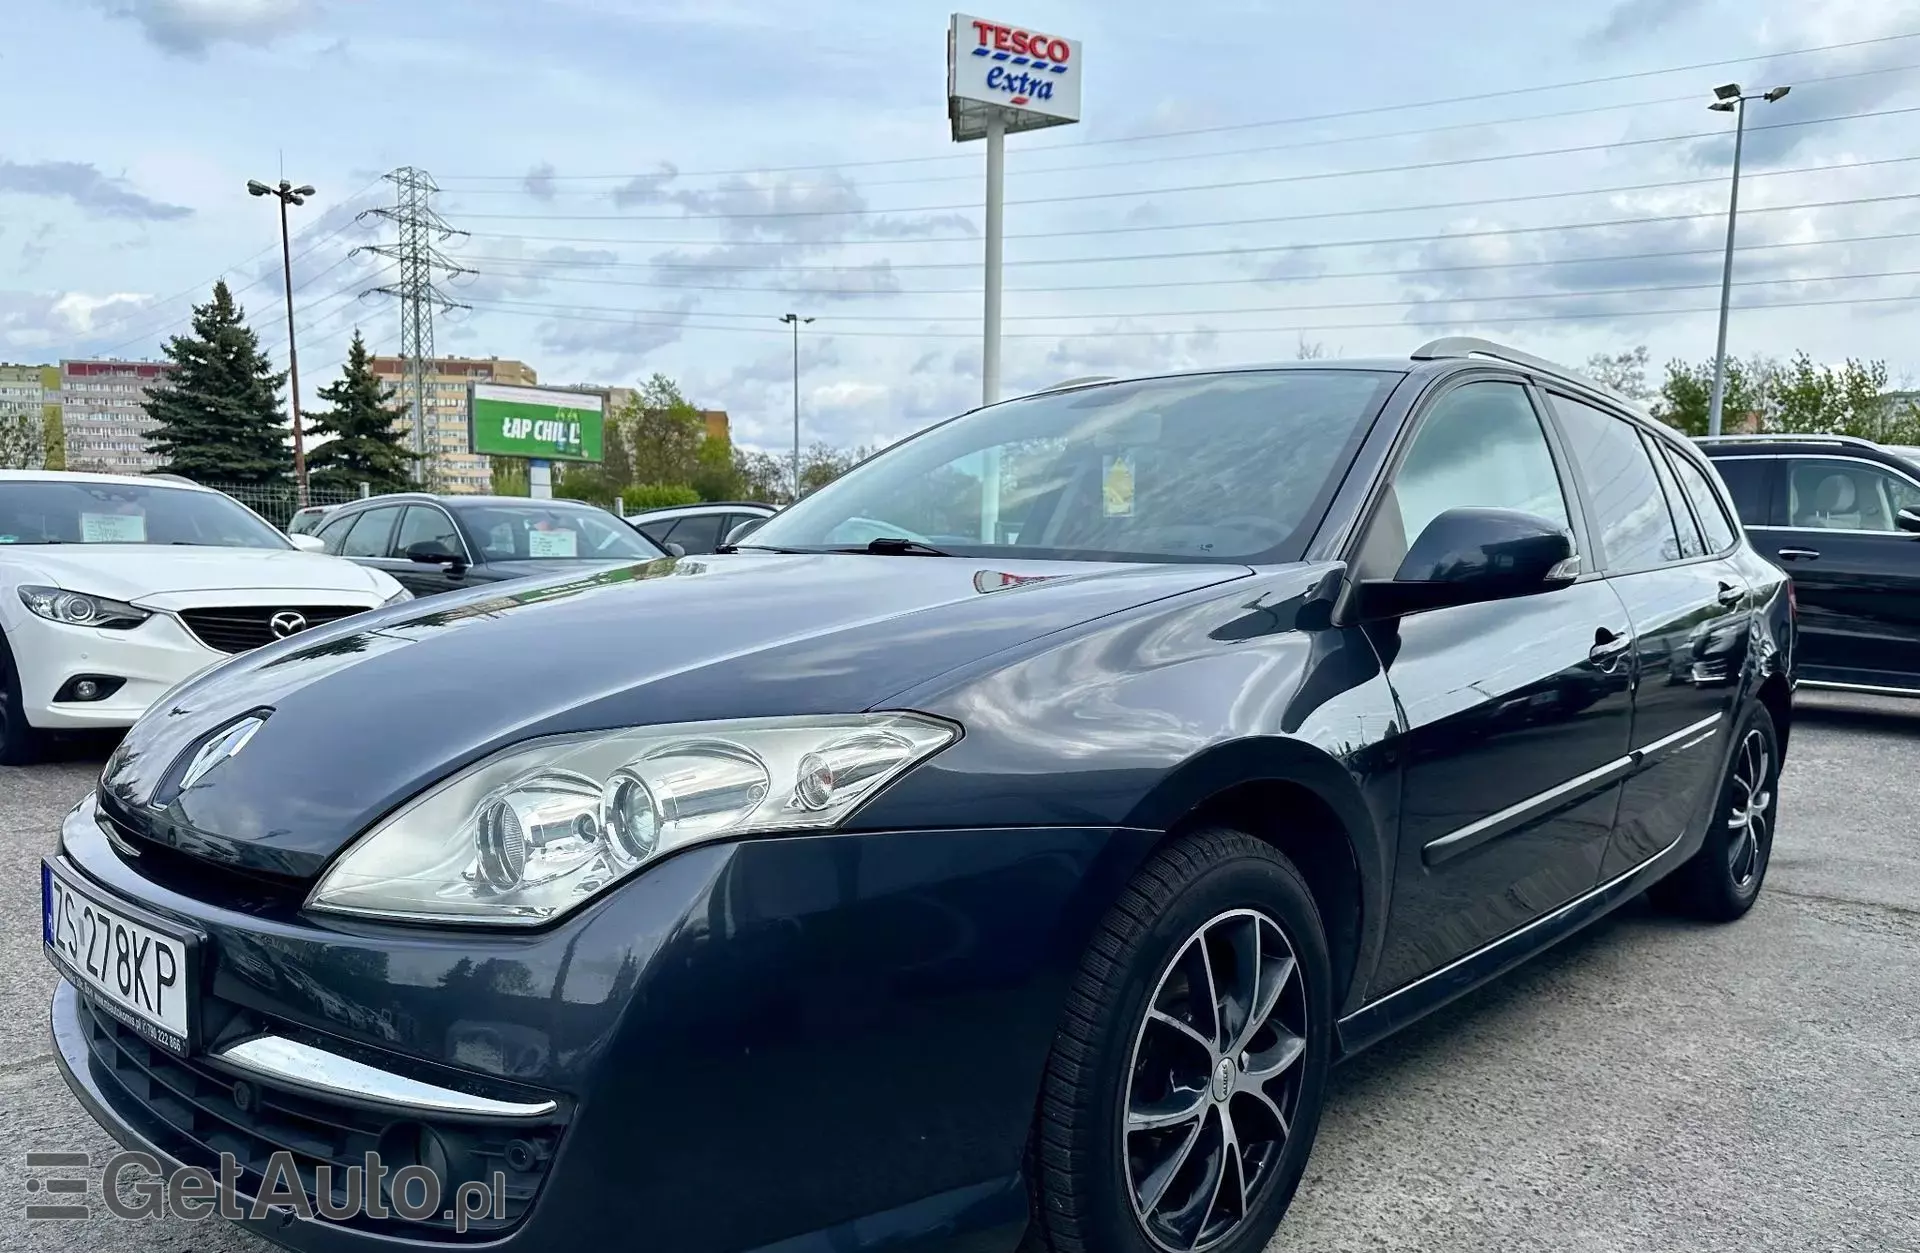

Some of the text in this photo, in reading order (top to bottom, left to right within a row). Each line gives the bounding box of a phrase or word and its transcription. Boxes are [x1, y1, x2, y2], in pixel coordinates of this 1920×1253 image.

[973, 20, 1070, 63] TESCO
[986, 65, 1053, 100] extra
[502, 417, 532, 439] ŁAP
[54, 881, 78, 958] ZS
[83, 906, 176, 1016] 278KP
